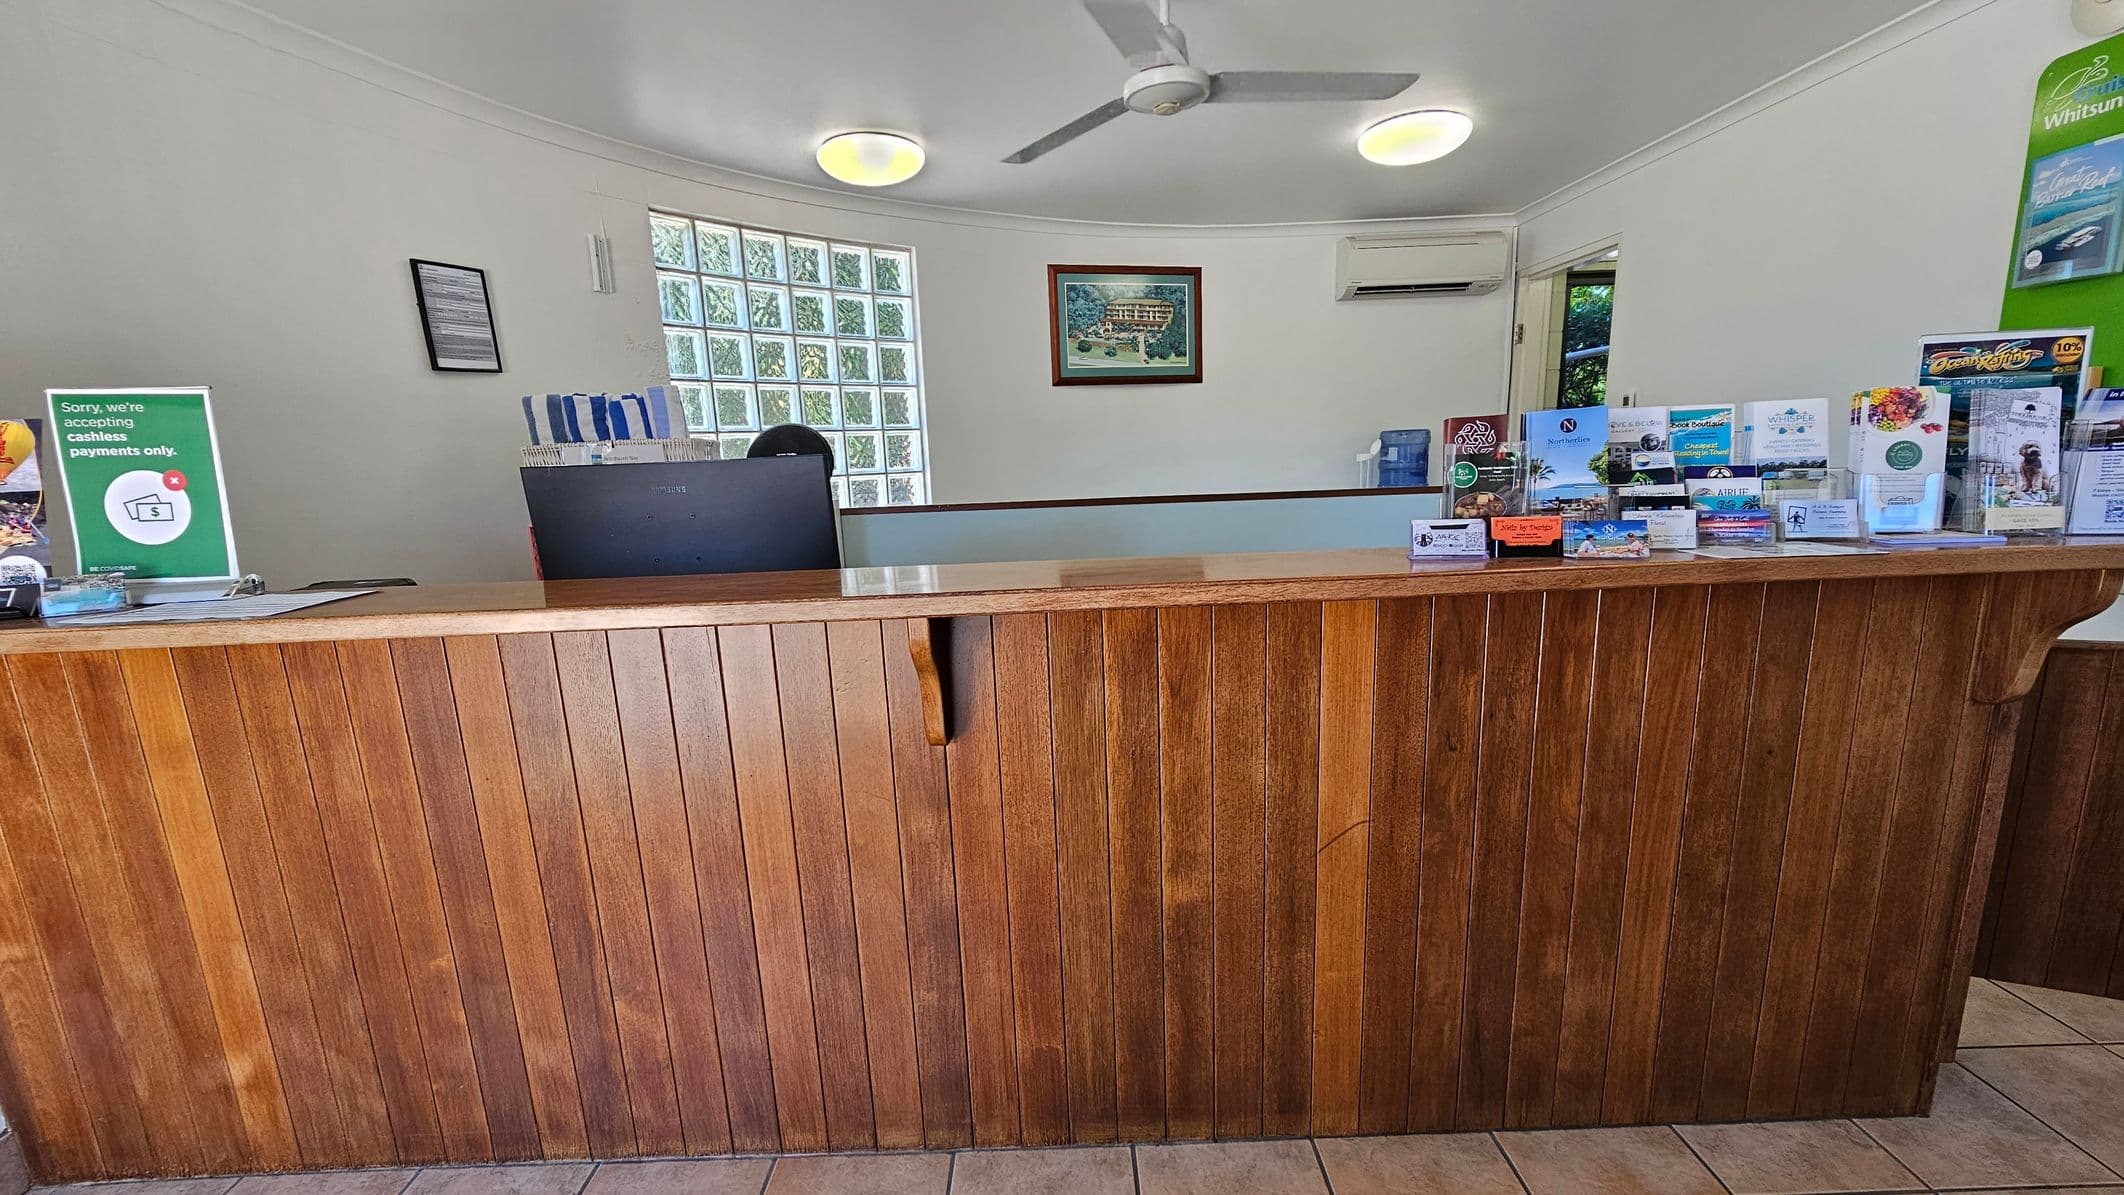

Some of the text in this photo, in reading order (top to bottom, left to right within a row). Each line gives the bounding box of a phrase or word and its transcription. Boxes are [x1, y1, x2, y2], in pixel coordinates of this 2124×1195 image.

[2045, 96, 2123, 129] Whitsun
[2056, 342, 2083, 352] 10%
[61, 401, 144, 414] Sorry, we're
[64, 416, 134, 429] accepting
[1767, 414, 1815, 424] WHISPER
[1692, 420, 1725, 429] Boutique
[67, 431, 128, 442] cashless
[1547, 436, 1591, 445] Northerlies
[1685, 442, 1718, 450] Cheapest
[70, 445, 177, 458] payments only.
